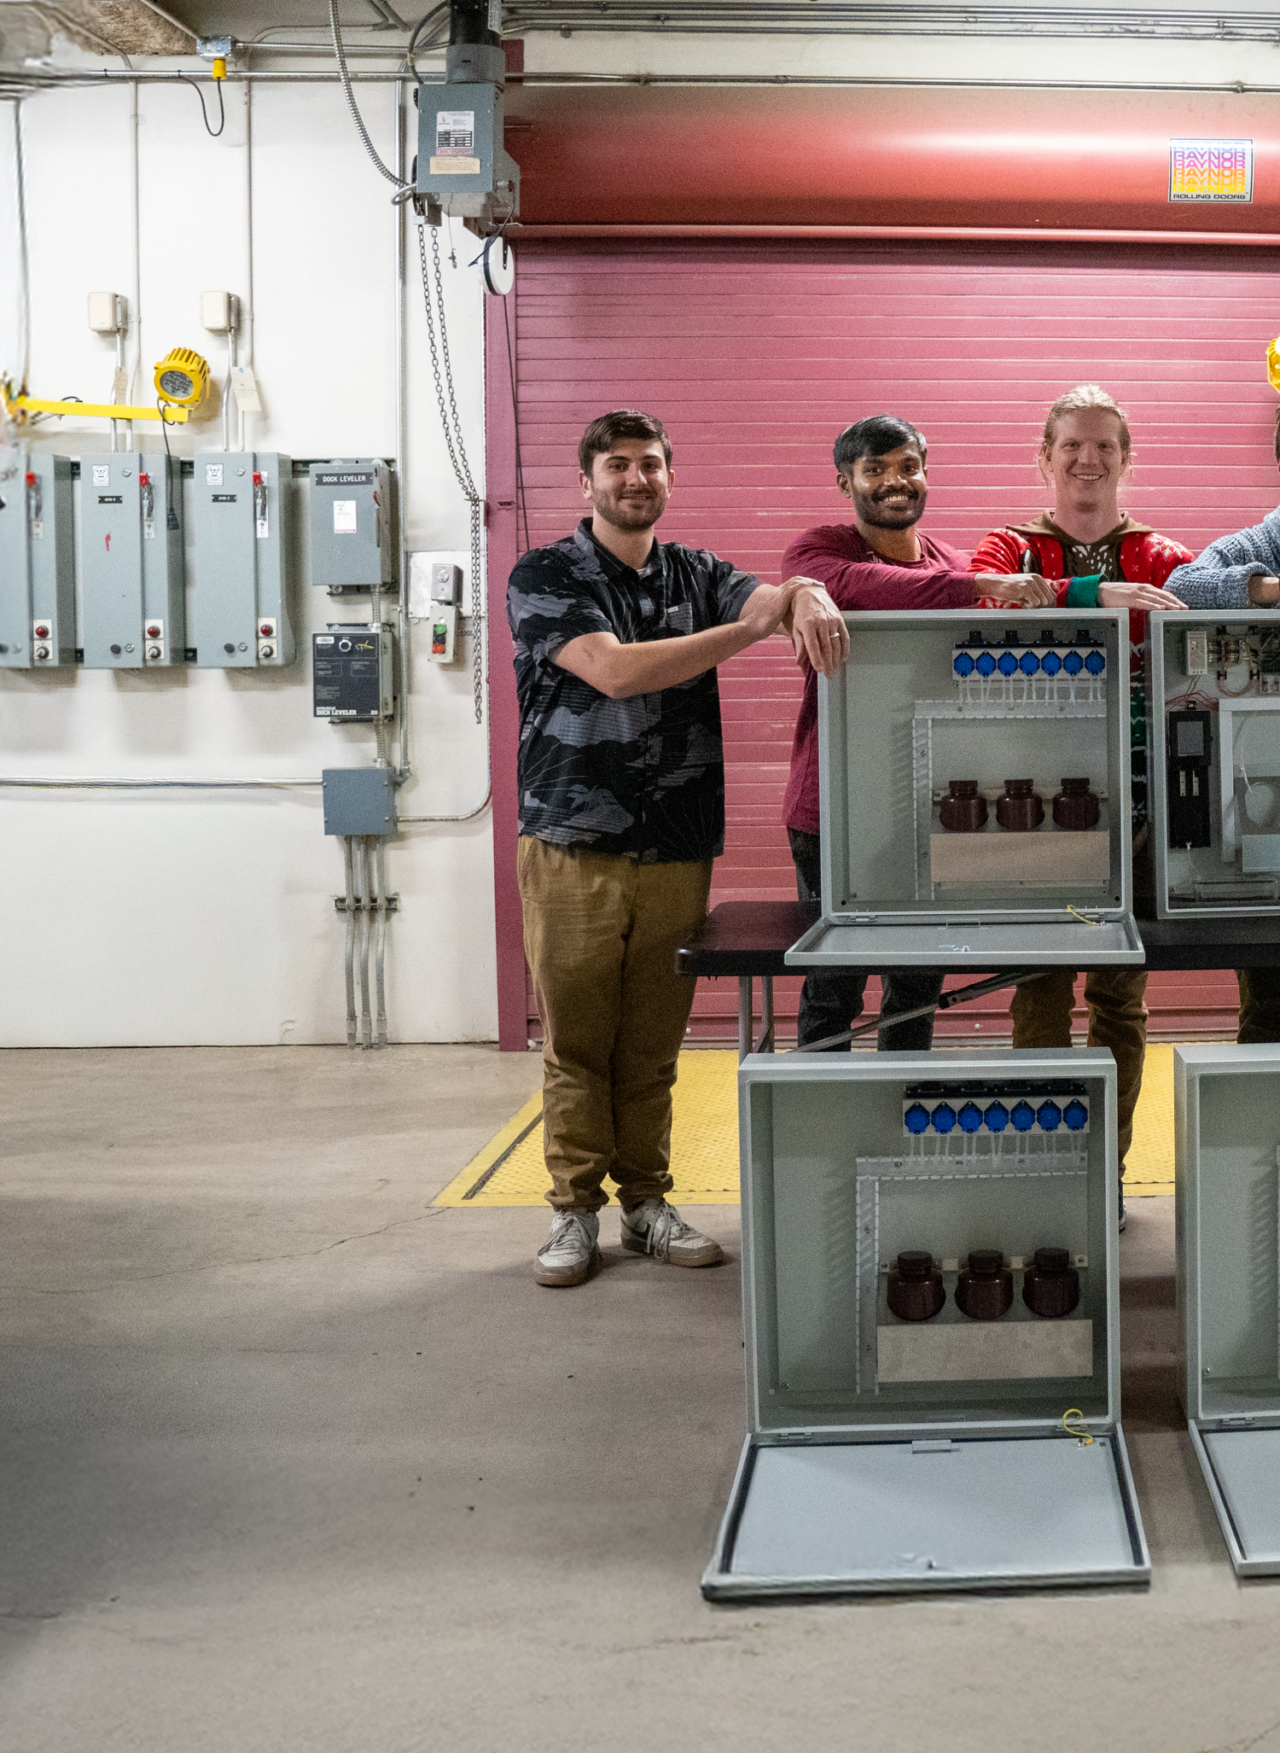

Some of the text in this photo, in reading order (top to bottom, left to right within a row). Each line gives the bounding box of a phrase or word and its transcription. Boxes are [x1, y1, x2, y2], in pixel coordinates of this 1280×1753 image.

[1173, 151, 1246, 160] RAYNOR
[1173, 159, 1246, 169] RAYNOR
[1173, 168, 1246, 178] RAYNOR
[1173, 177, 1246, 186] RAYNOR
[1172, 184, 1245, 194] RAYNOR
